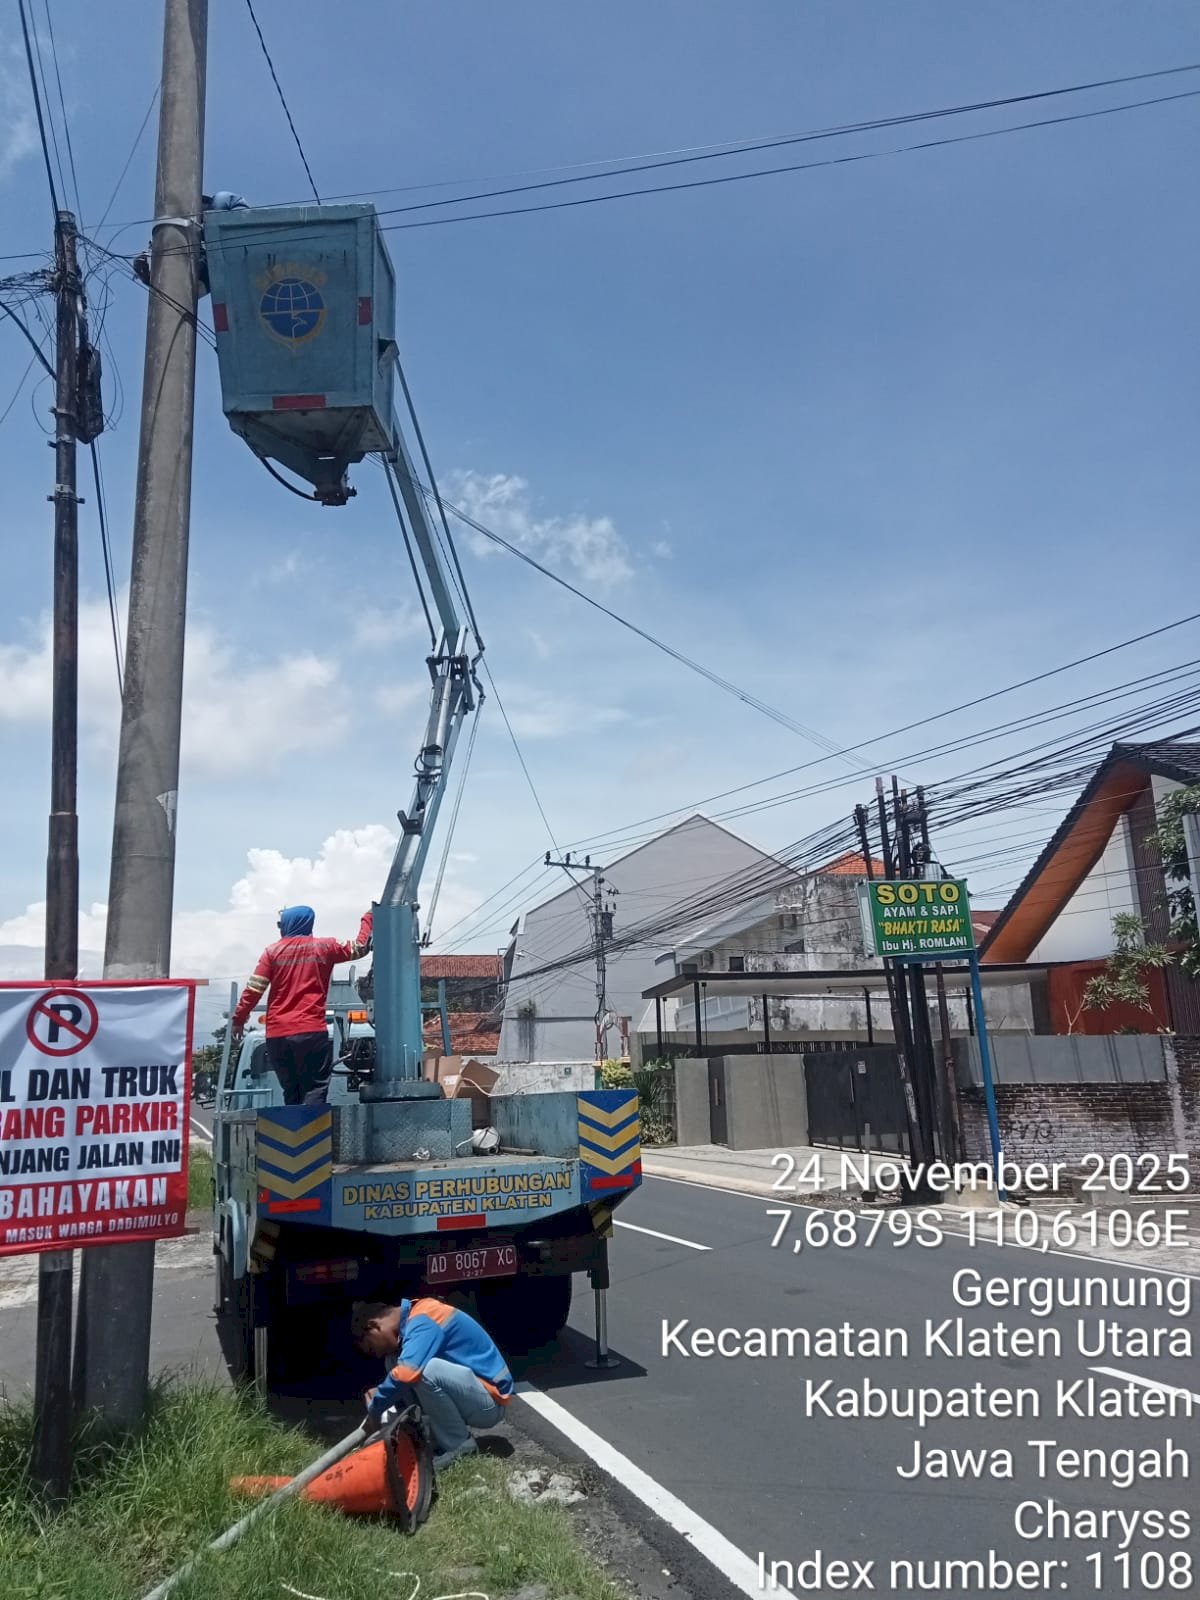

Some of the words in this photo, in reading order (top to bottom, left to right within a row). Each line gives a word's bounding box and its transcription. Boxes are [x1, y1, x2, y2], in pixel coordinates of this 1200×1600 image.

[876, 882, 960, 905] SOTO
[884, 906, 916, 918] AYAM
[920, 906, 928, 916] &
[932, 905, 959, 916] SAPI
[882, 940, 899, 951] Ibu
[902, 940, 917, 952] Hj.
[920, 936, 968, 949] ROMLANI
[28, 1068, 90, 1102] DAN
[101, 1065, 178, 1098] TRUK
[0, 1106, 66, 1141] ANG
[75, 1101, 177, 1137] PARKIR
[77, 1142, 144, 1170] JALAN
[152, 1138, 180, 1164] INI
[0, 1177, 167, 1221] BAHAYAKAN
[342, 1180, 410, 1205] DINAS
[415, 1171, 571, 1199] PERHUBUNGAN
[364, 1198, 476, 1220] KABUPATEN
[482, 1193, 552, 1211] KLATEN
[6, 1225, 52, 1244] MASUK
[58, 1219, 102, 1239] WARGA
[431, 1255, 447, 1274] AD
[455, 1250, 488, 1270] 8067
[496, 1248, 514, 1266] XC
